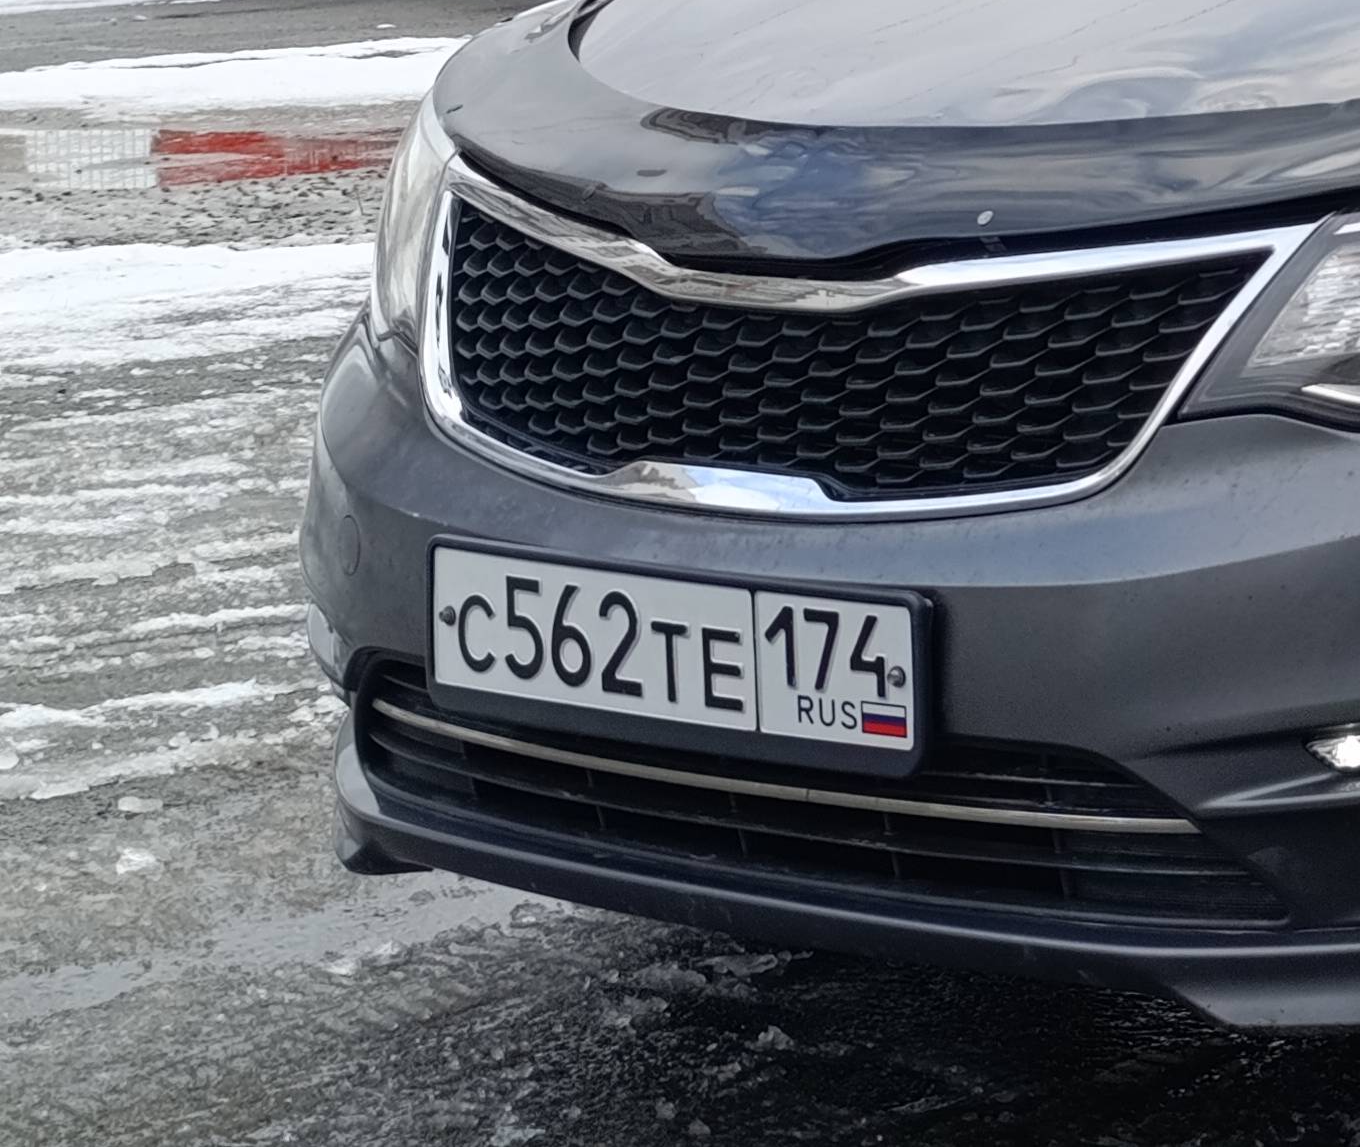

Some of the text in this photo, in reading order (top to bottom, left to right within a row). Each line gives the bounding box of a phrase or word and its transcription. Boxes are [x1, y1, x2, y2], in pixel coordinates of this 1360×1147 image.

[458, 575, 888, 712] С562ТЕ 174
[797, 696, 857, 730] RUS
